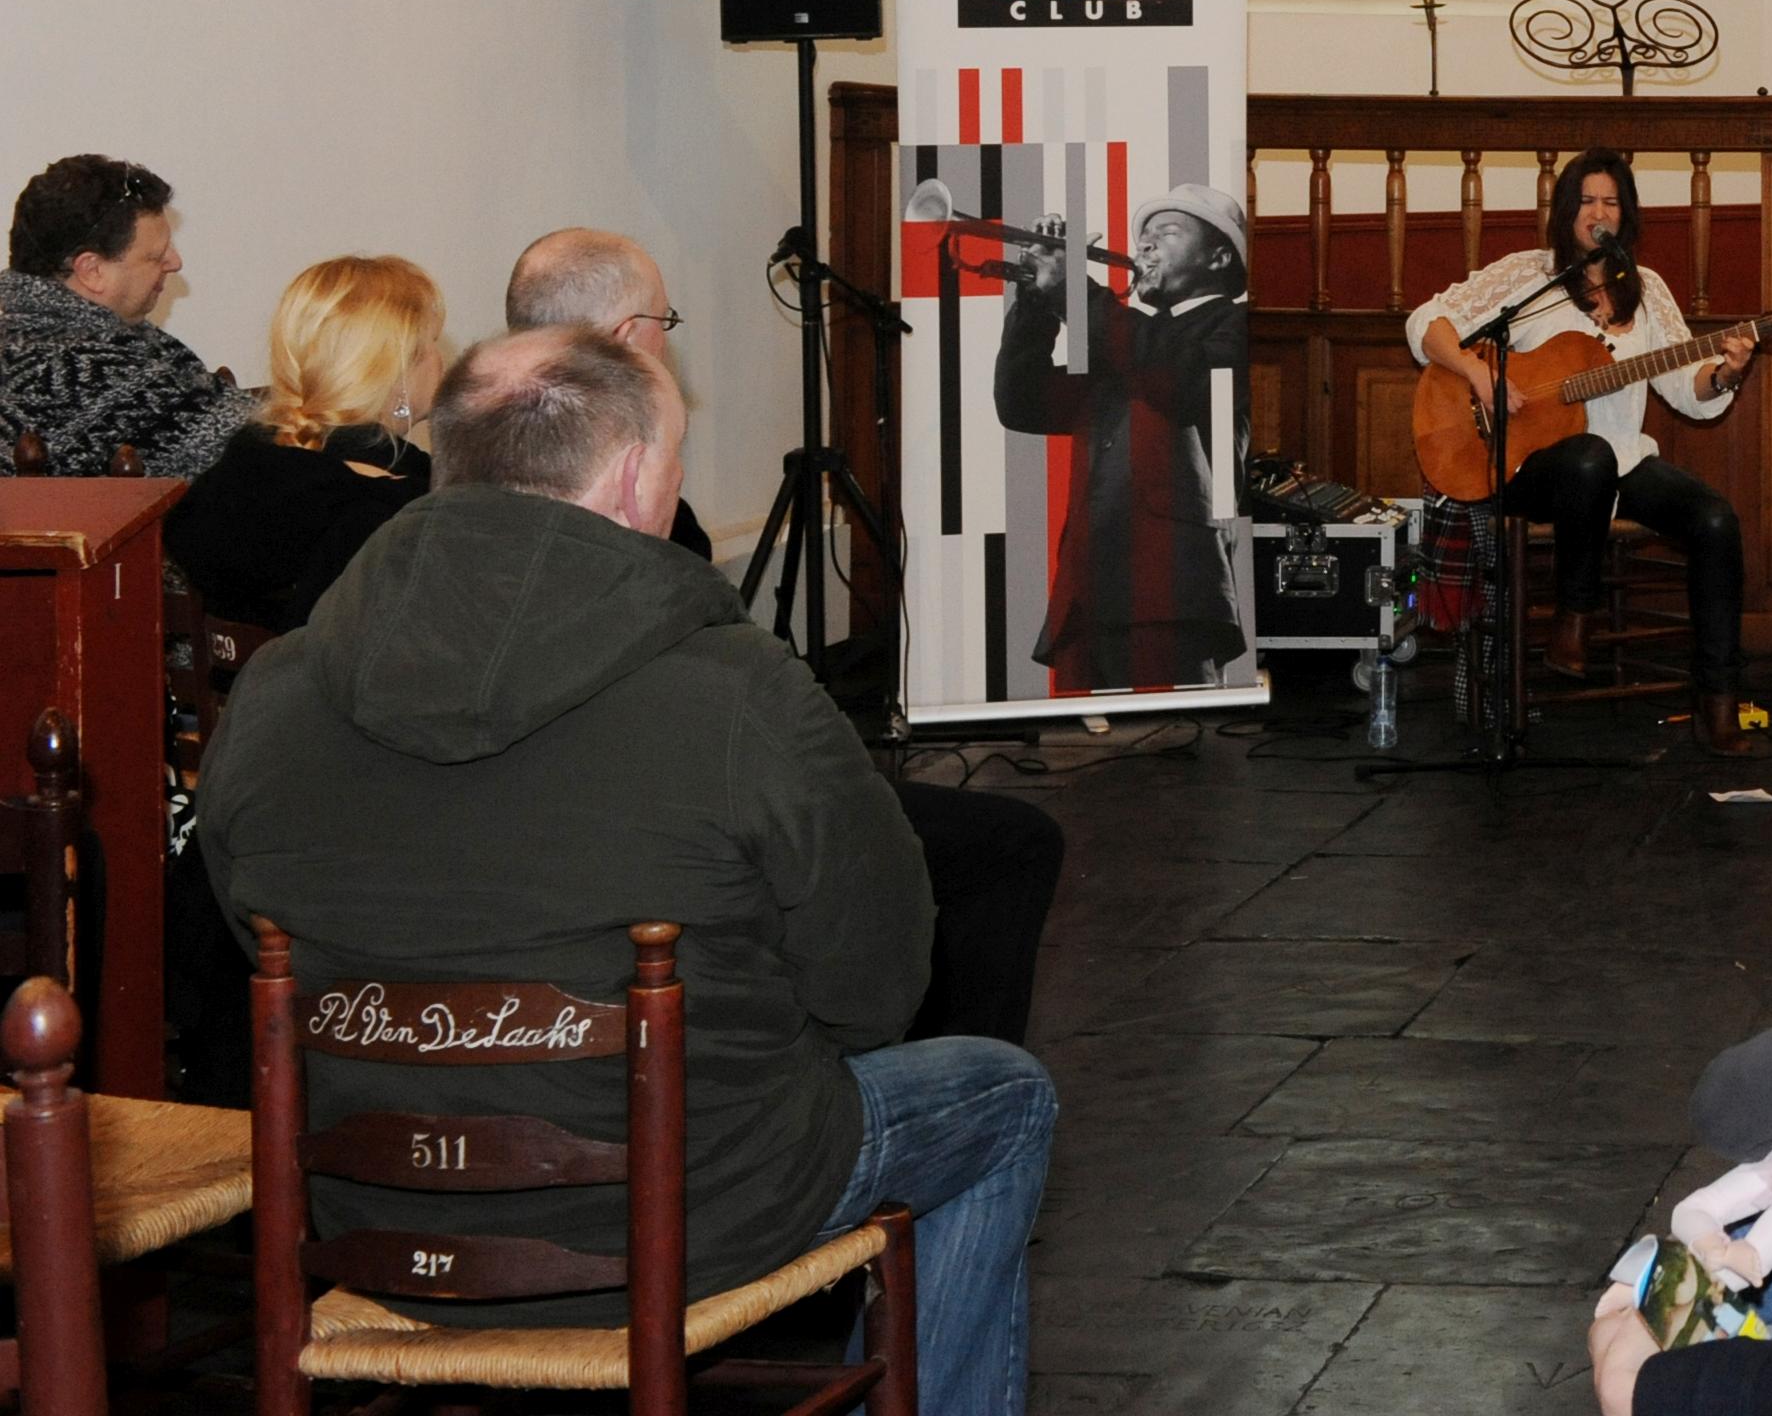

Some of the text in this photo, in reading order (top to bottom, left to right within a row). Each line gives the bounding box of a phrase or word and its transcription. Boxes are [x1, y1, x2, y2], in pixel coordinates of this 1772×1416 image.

[1009, 0, 1143, 20] CLUB
[411, 1134, 467, 1170] 511
[411, 1250, 455, 1277] 217
